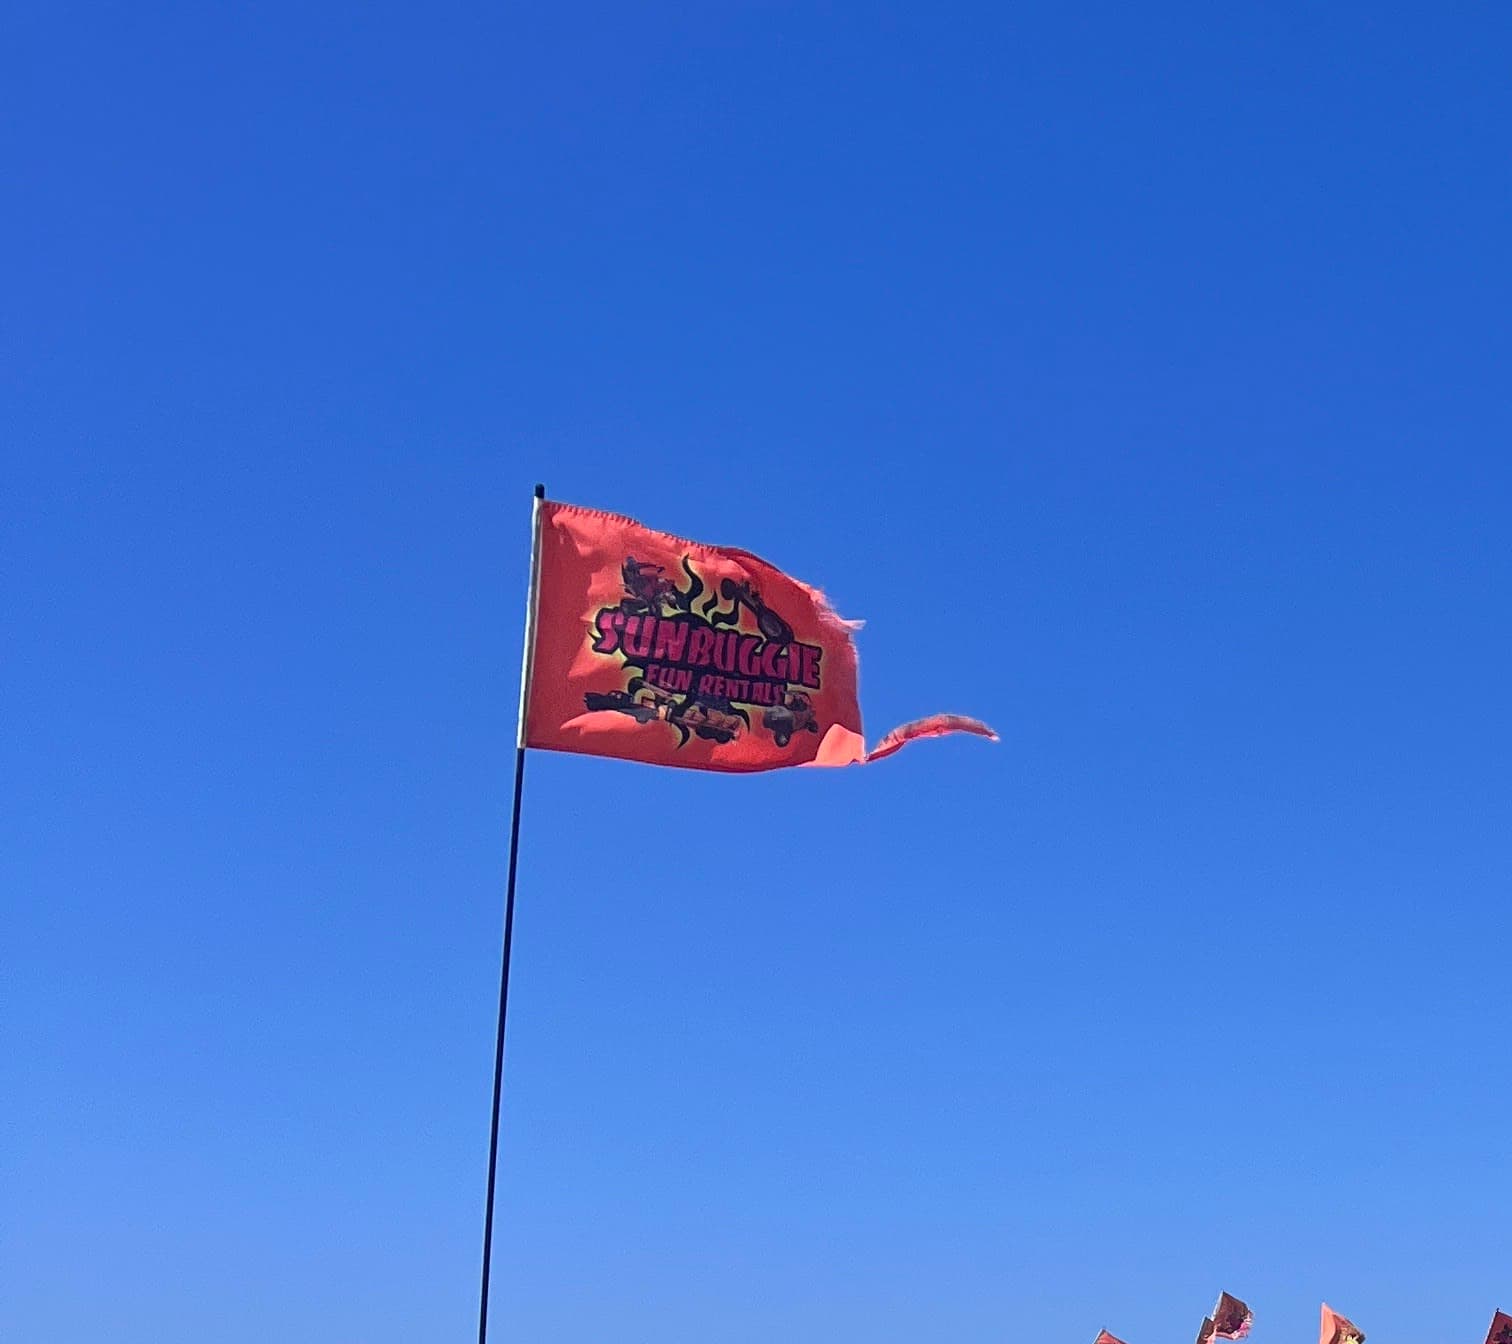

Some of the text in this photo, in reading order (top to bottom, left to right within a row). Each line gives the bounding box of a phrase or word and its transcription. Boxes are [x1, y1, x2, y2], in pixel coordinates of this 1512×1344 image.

[597, 609, 821, 689] SUNBUGGIE
[645, 663, 785, 706] FUN RENTALS
